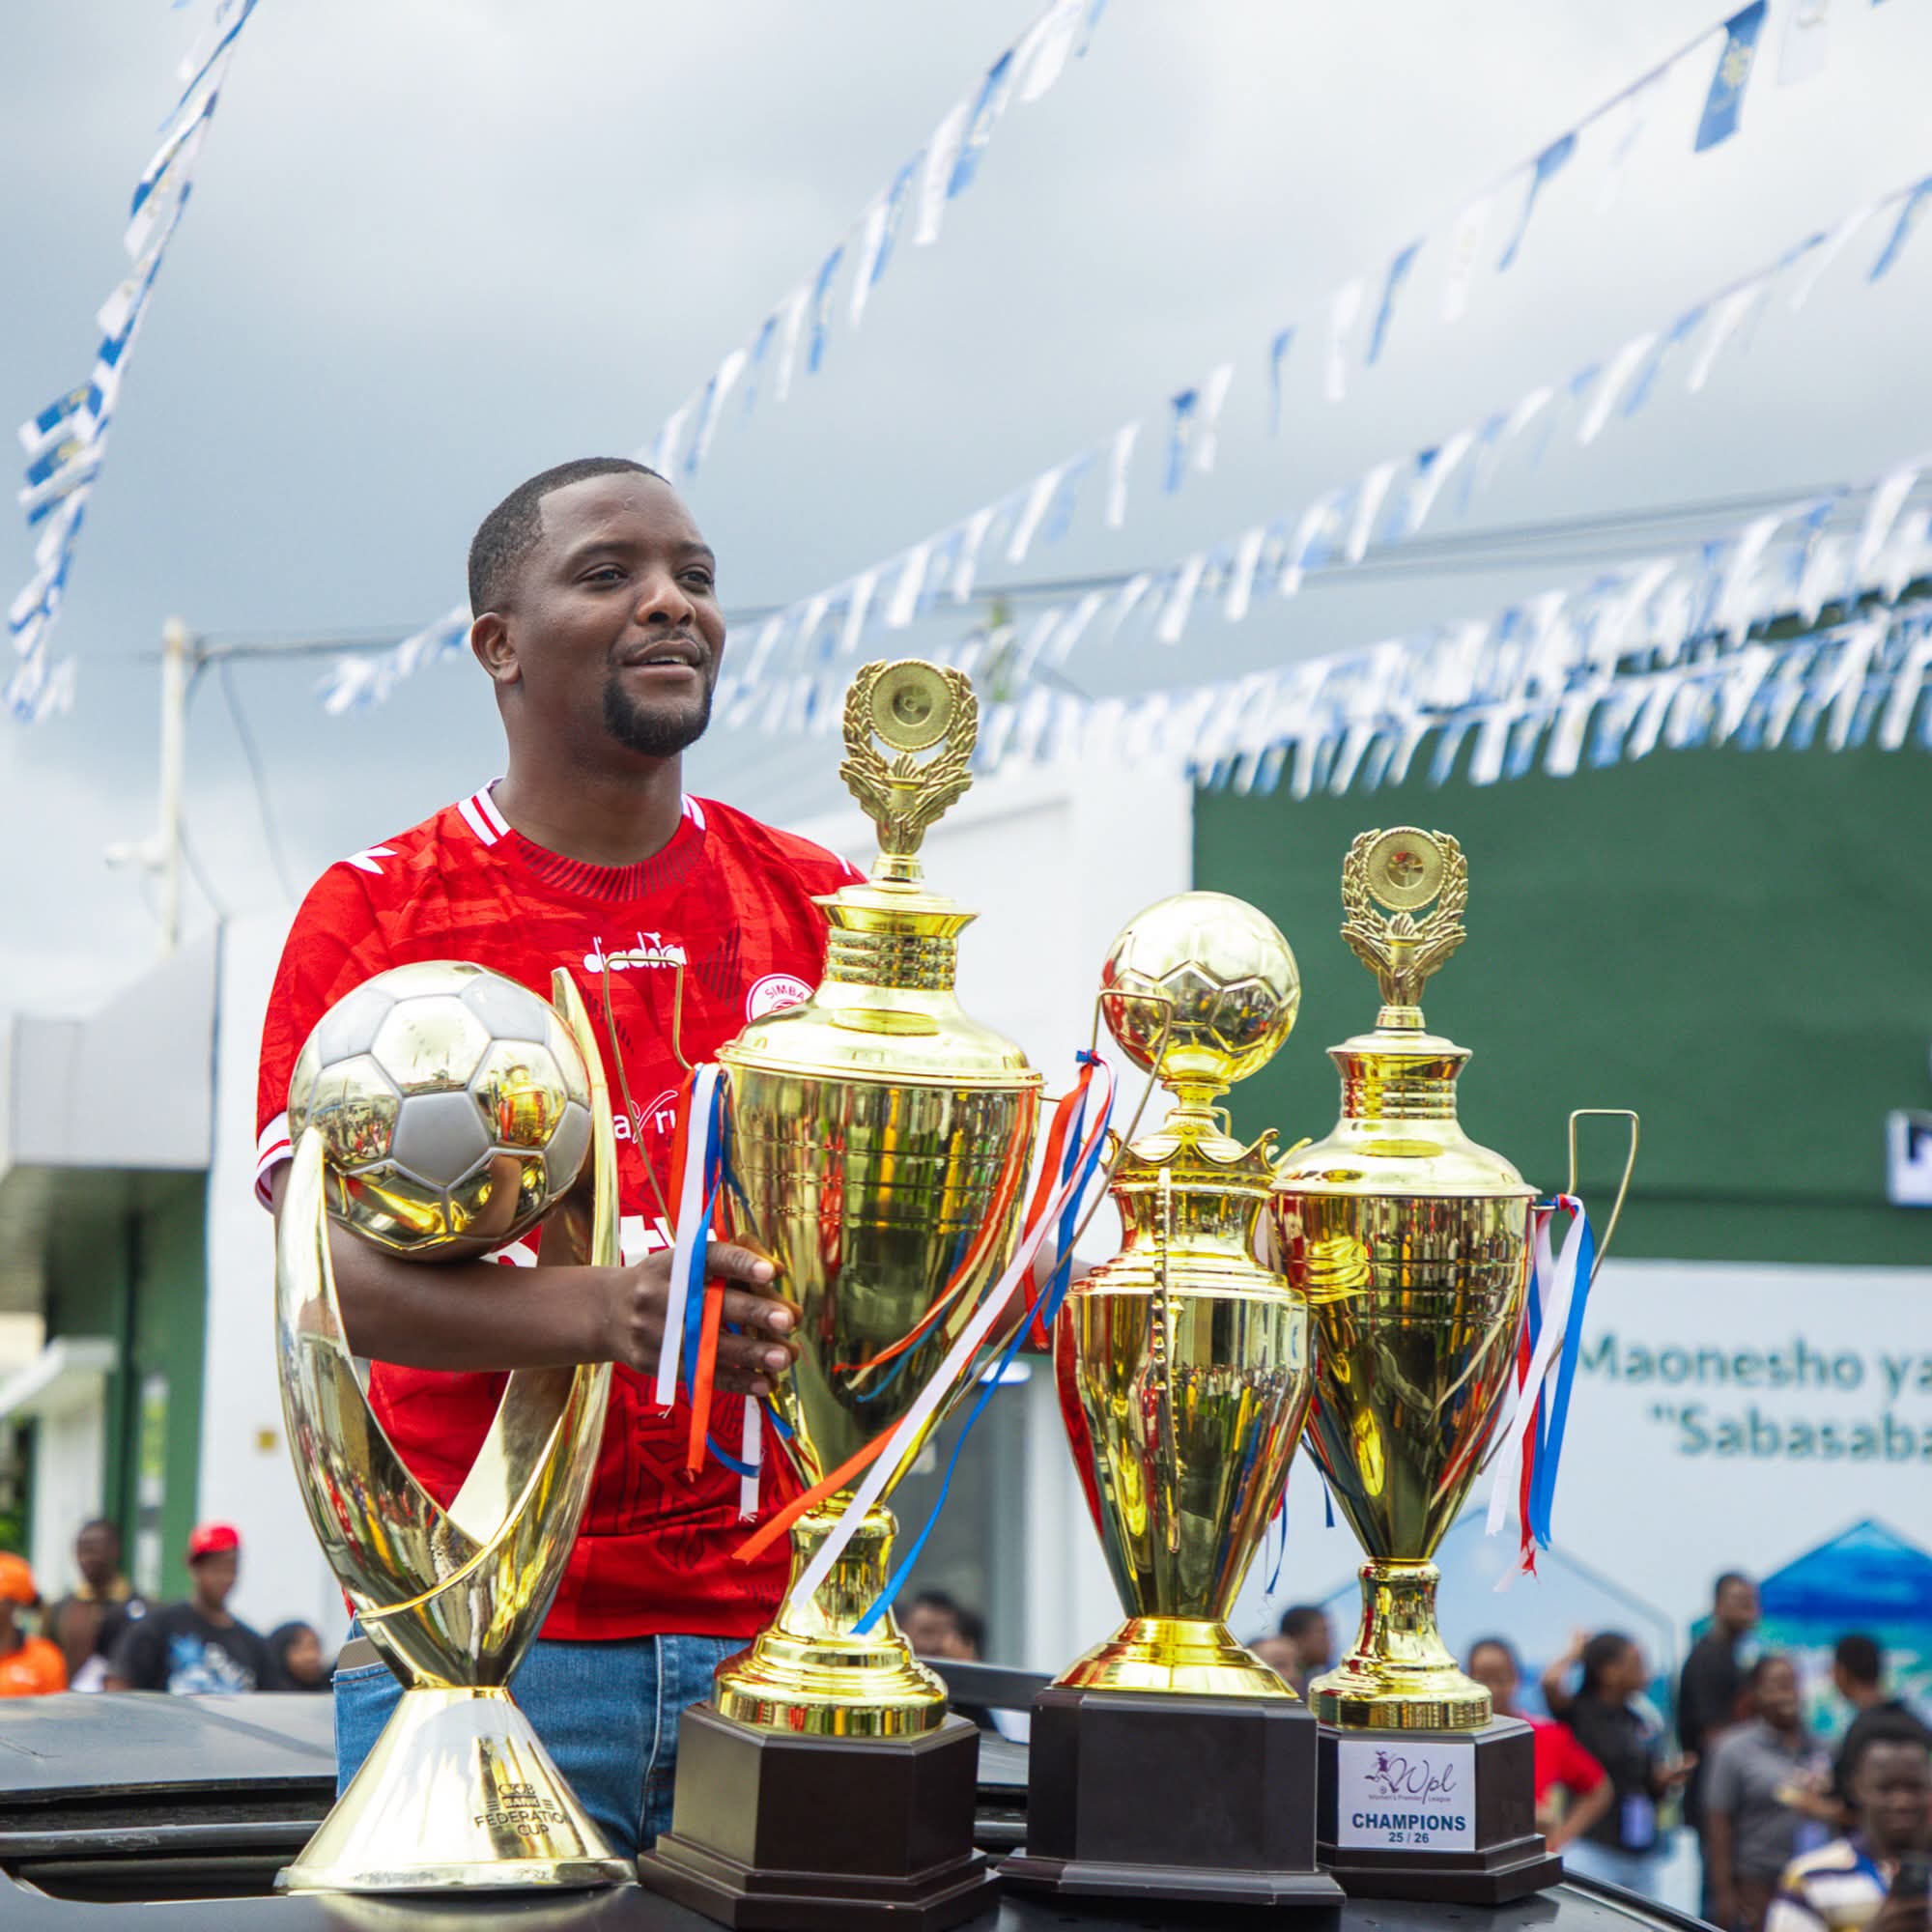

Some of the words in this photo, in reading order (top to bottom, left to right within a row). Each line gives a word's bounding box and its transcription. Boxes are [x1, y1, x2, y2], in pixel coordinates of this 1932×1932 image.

[764, 984, 805, 1004] SIMBA
[1577, 1332, 1864, 1391] Maonesho
[474, 1810, 566, 1829] FEDERATIO
[517, 1823, 549, 1836] CUP
[1352, 1812, 1466, 1832] CHAMPIONS
